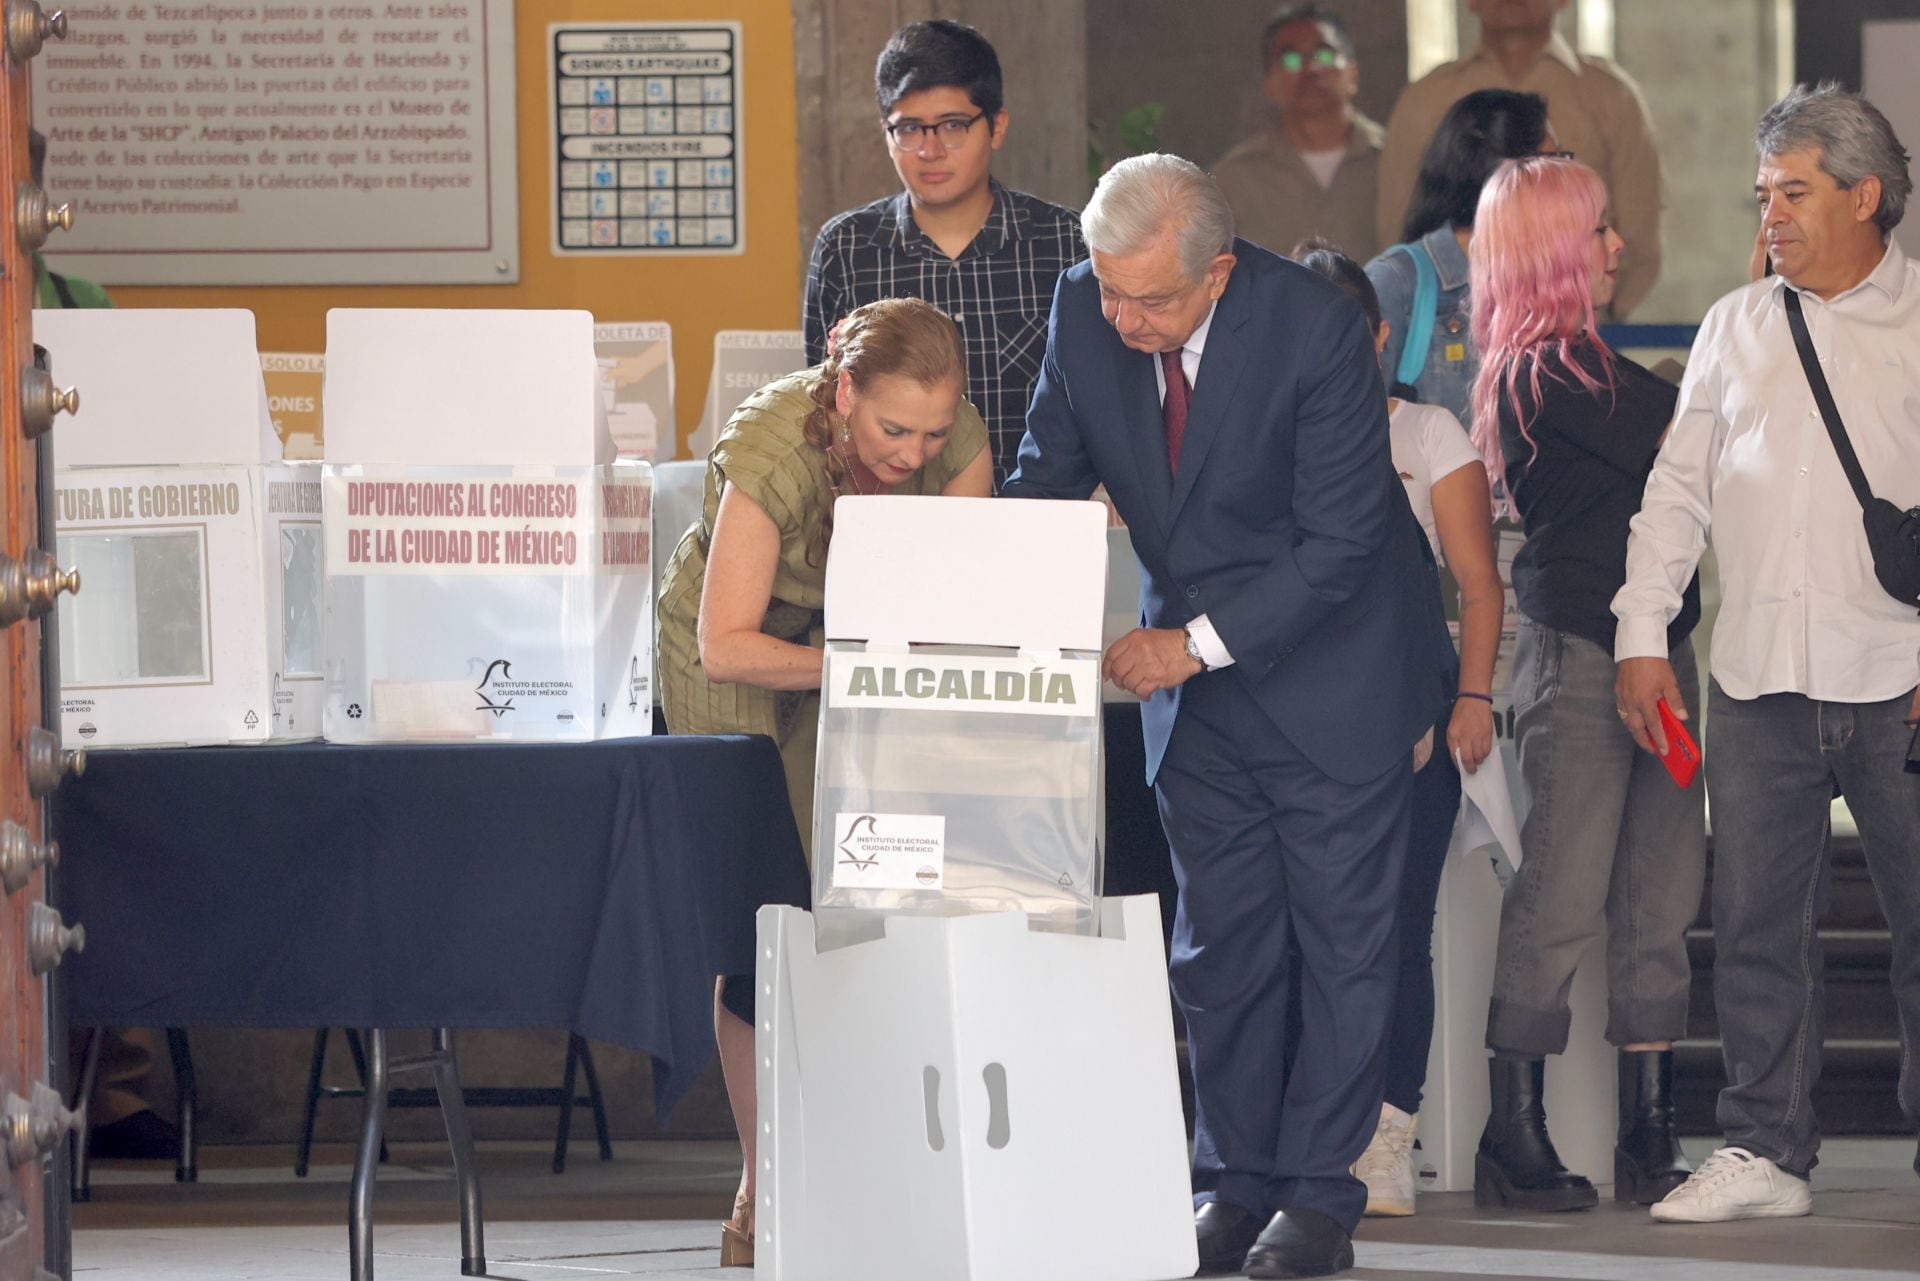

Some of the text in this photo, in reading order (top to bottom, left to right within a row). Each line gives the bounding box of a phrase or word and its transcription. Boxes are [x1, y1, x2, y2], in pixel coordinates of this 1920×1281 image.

[126, 4, 147, 21] de
[262, 5, 308, 24] junto
[313, 7, 324, 20] a
[384, 4, 423, 19] Ante
[428, 3, 469, 19] tales
[212, 29, 226, 44] la
[241, 28, 324, 44] necesidad
[338, 27, 358, 44] de
[373, 30, 438, 43] rescatar
[453, 27, 470, 43] el
[140, 52, 161, 69] En
[226, 52, 242, 68] la
[344, 51, 363, 68] de
[374, 51, 451, 67] Hacienda
[460, 55, 471, 72] y
[48, 78, 109, 92] Crédito
[235, 77, 256, 92] las
[264, 80, 325, 96] puertas
[333, 76, 358, 92] del
[434, 80, 470, 94] para
[49, 102, 140, 116] convertirlo
[147, 106, 166, 116] en
[174, 101, 190, 116] lo
[197, 105, 225, 120] que
[344, 104, 361, 116] es
[368, 101, 382, 115] el
[390, 100, 444, 115] Museo
[450, 99, 471, 115] de
[51, 127, 83, 142] Arte
[88, 126, 107, 142] de
[112, 125, 127, 141] la
[201, 126, 266, 145] Antiguo
[270, 124, 329, 141] Palacio
[332, 124, 358, 140] del
[50, 150, 85, 166] sede
[96, 150, 114, 165] de
[124, 150, 146, 165] las
[155, 150, 249, 165] colecciones
[258, 149, 277, 165] de
[287, 152, 318, 164] arte
[328, 153, 357, 168] que
[366, 148, 381, 163] la
[52, 178, 91, 190] tiene
[96, 175, 133, 193] bajo
[138, 178, 155, 189] su
[239, 173, 254, 189] la
[257, 173, 339, 190] Colección
[342, 172, 383, 192] Pago
[386, 176, 407, 189] en
[410, 172, 472, 191] Especie
[82, 199, 139, 214] Acervo
[594, 326, 668, 341] OLETA DE
[720, 334, 761, 348] META
[265, 357, 306, 370] SOLO
[108, 486, 134, 519] DE
[138, 482, 240, 518] GOBIERNO
[348, 482, 464, 517] DIPUTACIONES
[467, 482, 486, 517] AL
[490, 483, 577, 519] CONGRESO
[348, 529, 371, 563] DE
[375, 529, 397, 563] LA
[401, 529, 472, 564] CIUDAD
[477, 530, 500, 564] DE
[505, 524, 577, 565] MÉXICO
[539, 688, 568, 696] MÉXICO
[847, 665, 1077, 705] ALCALDÍA
[857, 836, 940, 846] INSTITUTO ELECTORAL
[861, 844, 891, 852] CIUDAD
[904, 845, 934, 853] MÉXICO
